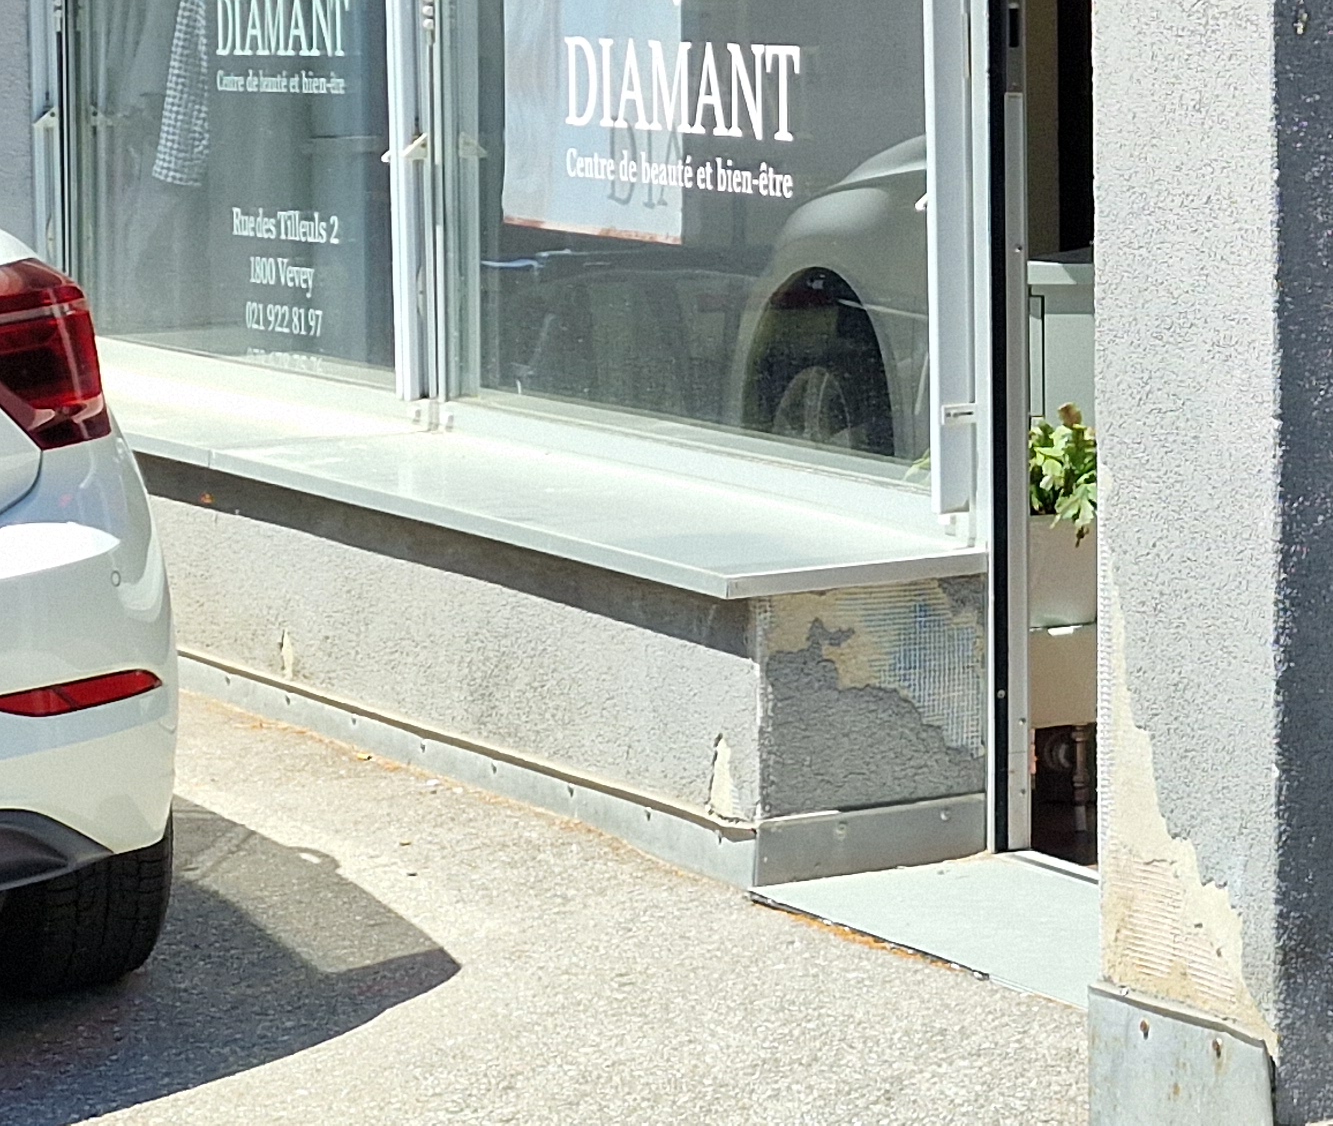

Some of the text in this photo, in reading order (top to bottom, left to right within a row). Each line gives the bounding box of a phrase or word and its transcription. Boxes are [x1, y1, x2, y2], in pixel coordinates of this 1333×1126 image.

[246, 69, 259, 92] de
[564, 36, 801, 142] DIAMANT
[565, 147, 794, 199] Centre de beauté et bien-être
[232, 207, 340, 245] Rue des Tilleuls 2
[250, 256, 315, 298] 1800 Vevey
[246, 301, 323, 337] 021 922 81 97
